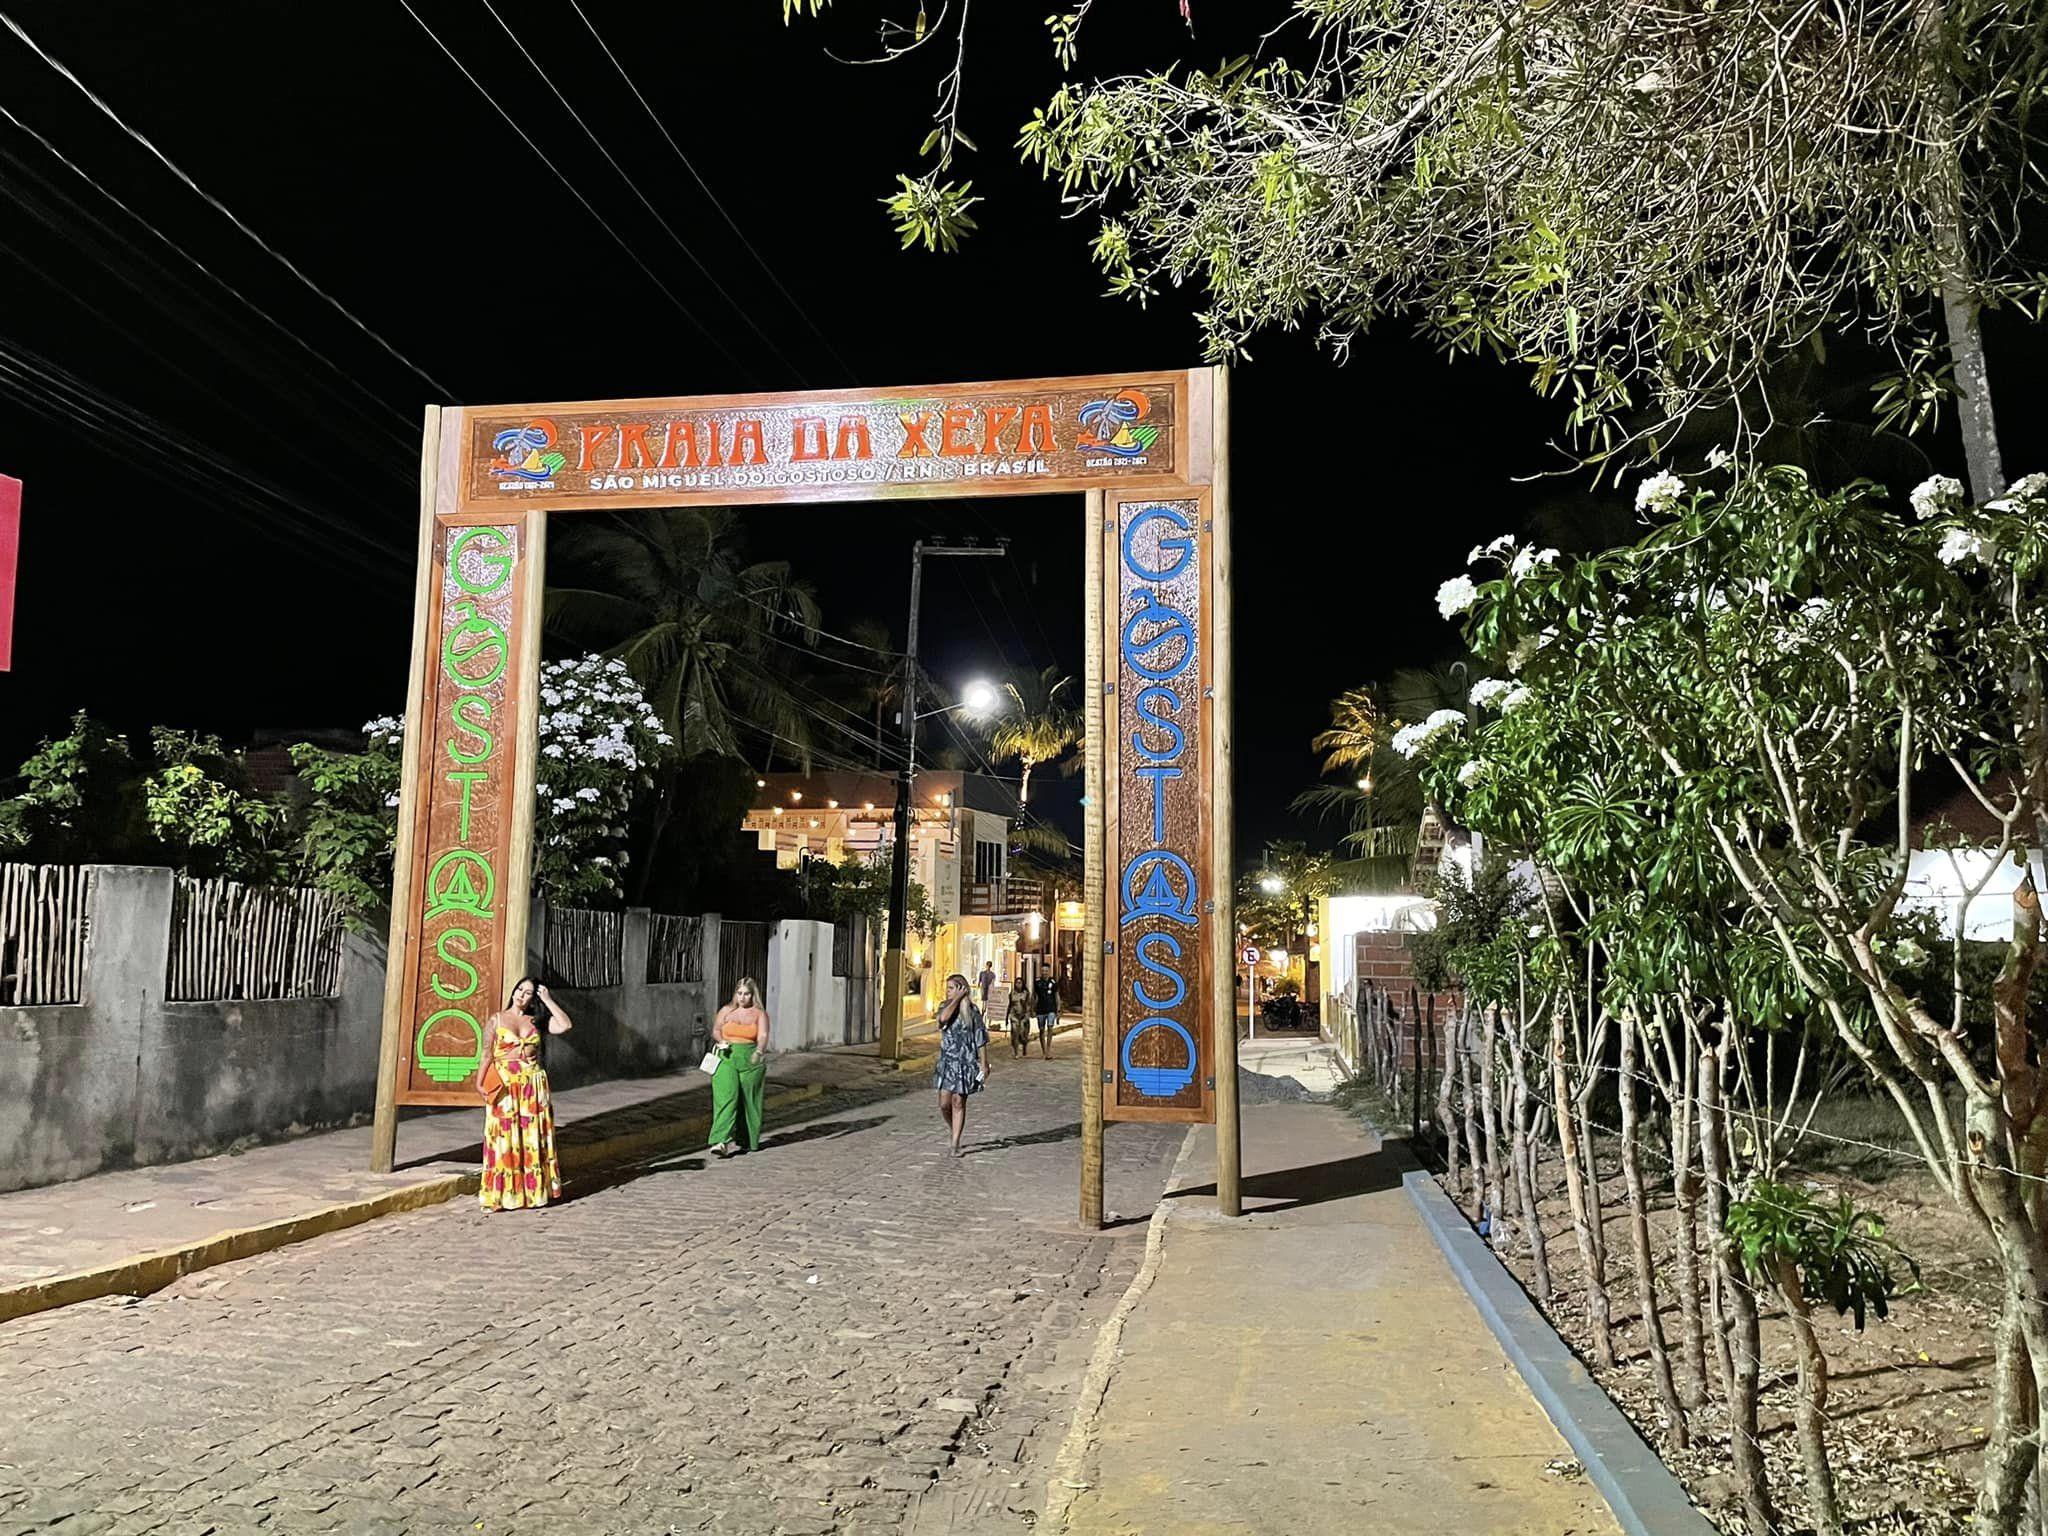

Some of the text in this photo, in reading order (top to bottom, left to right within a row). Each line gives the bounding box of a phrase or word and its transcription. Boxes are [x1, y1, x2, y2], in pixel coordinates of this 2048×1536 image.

[577, 418, 769, 471] PRAIA
[791, 415, 873, 462] DA
[590, 472, 635, 490] SÃO
[642, 471, 726, 489] MIGUEL
[733, 470, 763, 486] DO
[771, 467, 876, 485] GOSTOSO
[903, 465, 933, 479] RN
[963, 459, 1050, 477] BRASIL
